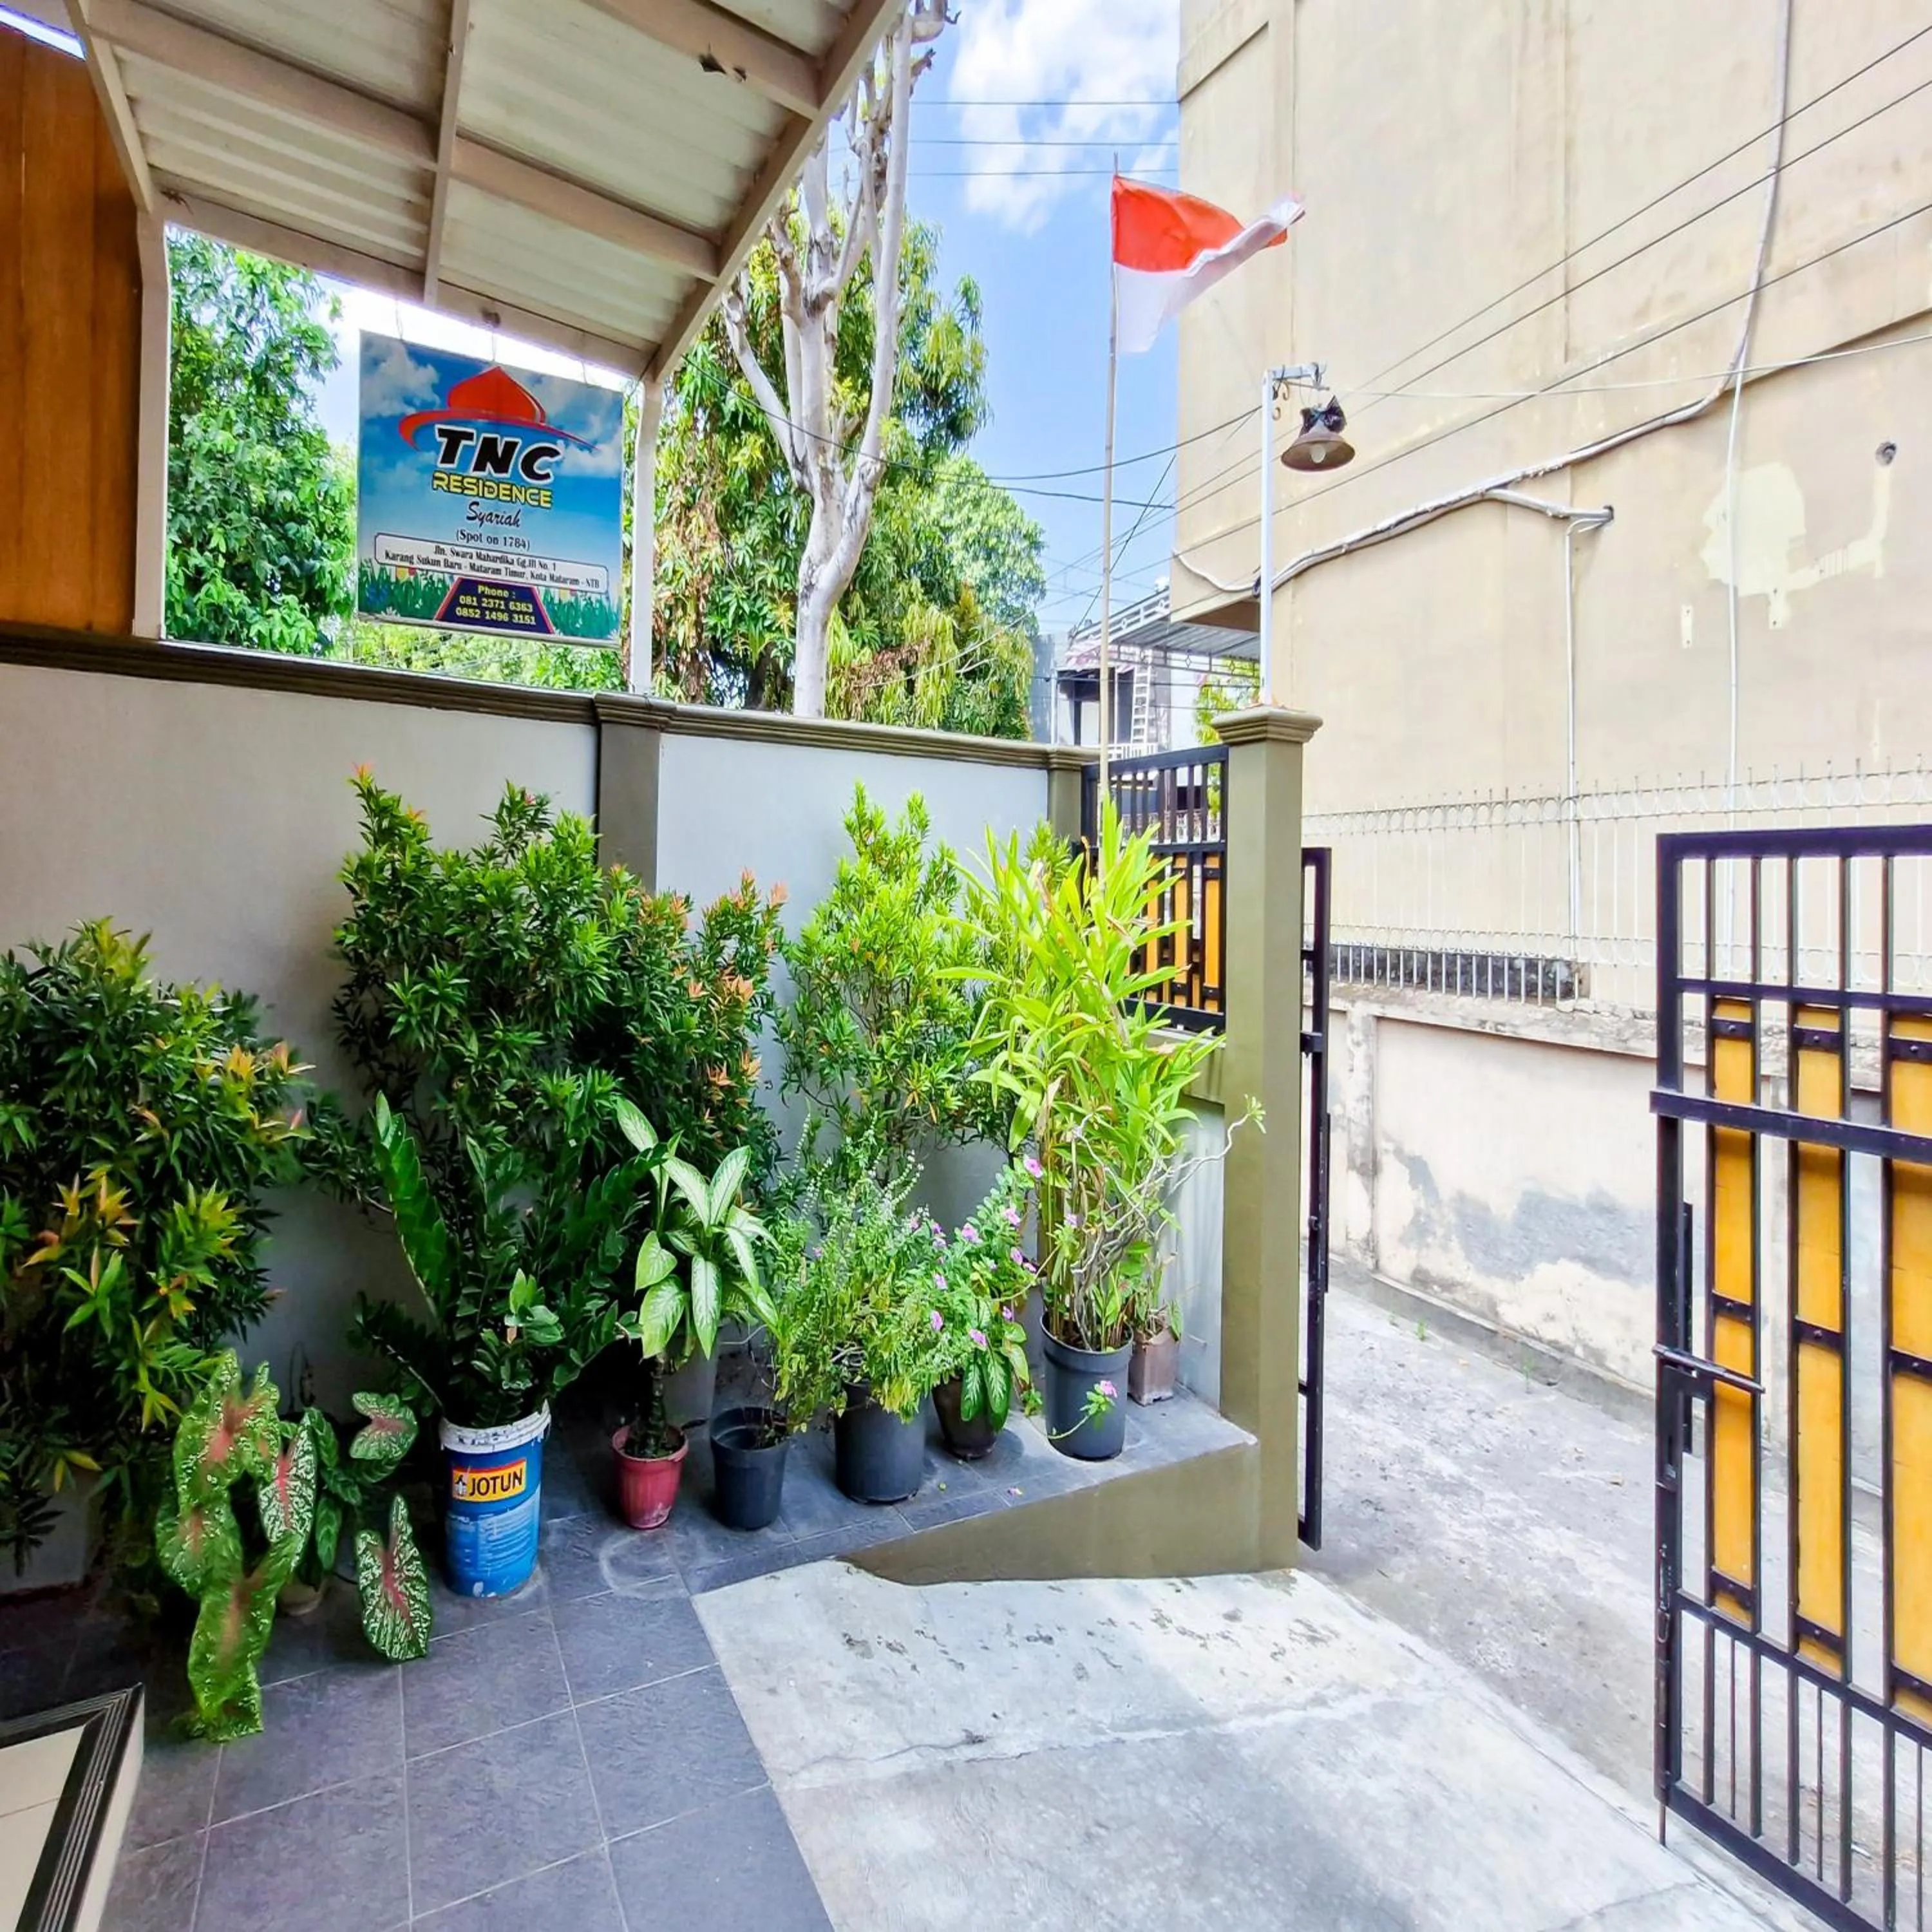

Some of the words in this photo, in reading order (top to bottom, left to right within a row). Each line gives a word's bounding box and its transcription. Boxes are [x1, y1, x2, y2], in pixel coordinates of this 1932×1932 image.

[436, 425, 562, 484] TNC
[433, 471, 553, 508] RESIDENCE
[466, 501, 520, 528] Syariah
[456, 529, 482, 543] (Spot
[486, 535, 499, 545] on
[503, 536, 530, 551] 1784)
[451, 547, 473, 559] Swara
[476, 551, 515, 565] Mahardika
[384, 549, 414, 565] Karang
[417, 554, 440, 567] Sukun
[444, 558, 462, 569] Baru
[469, 562, 502, 575] Mataram
[531, 571, 547, 582] Kota
[549, 573, 580, 585] Mataram
[586, 578, 600, 589] NTB
[459, 595, 477, 606] 081
[481, 598, 506, 609] 2371
[478, 585, 509, 598] Phone
[455, 607, 480, 618] 0852
[485, 611, 509, 621] 1496
[469, 1468, 522, 1496] JOTUN
